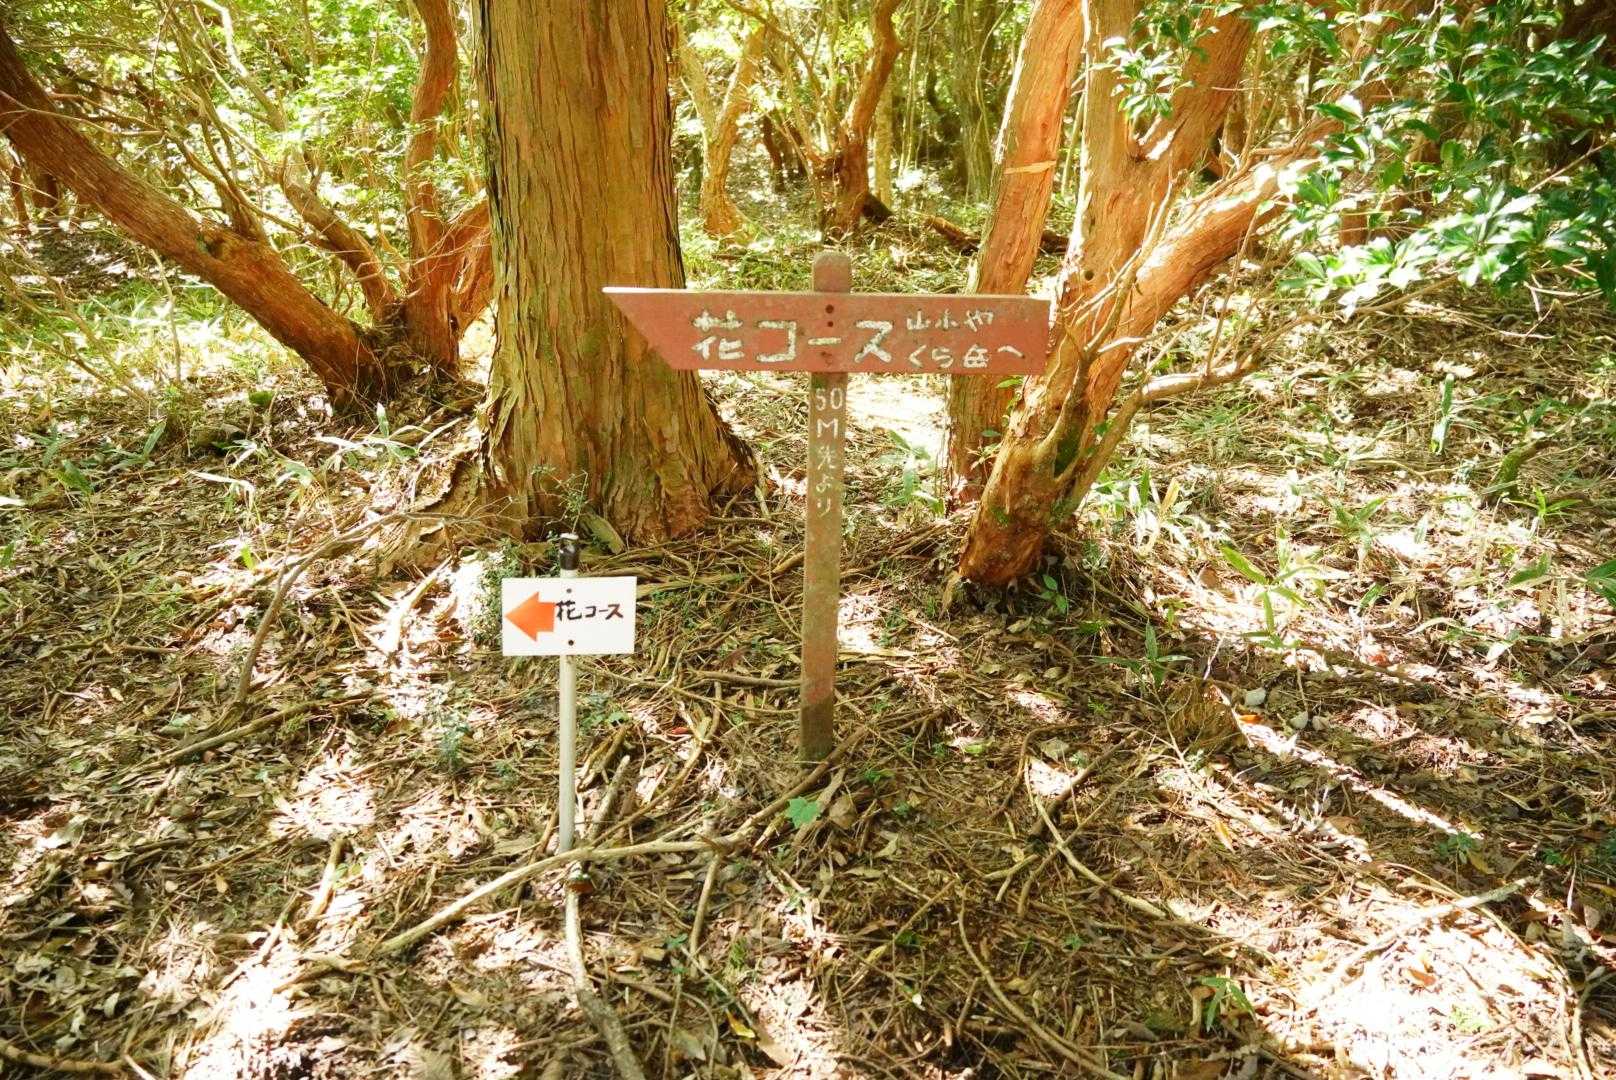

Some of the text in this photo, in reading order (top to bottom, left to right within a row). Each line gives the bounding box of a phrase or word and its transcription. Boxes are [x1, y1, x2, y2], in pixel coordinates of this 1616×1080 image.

[906, 309, 994, 332] 山小や
[691, 309, 893, 363] 花コース
[556, 600, 624, 621] 花コース
